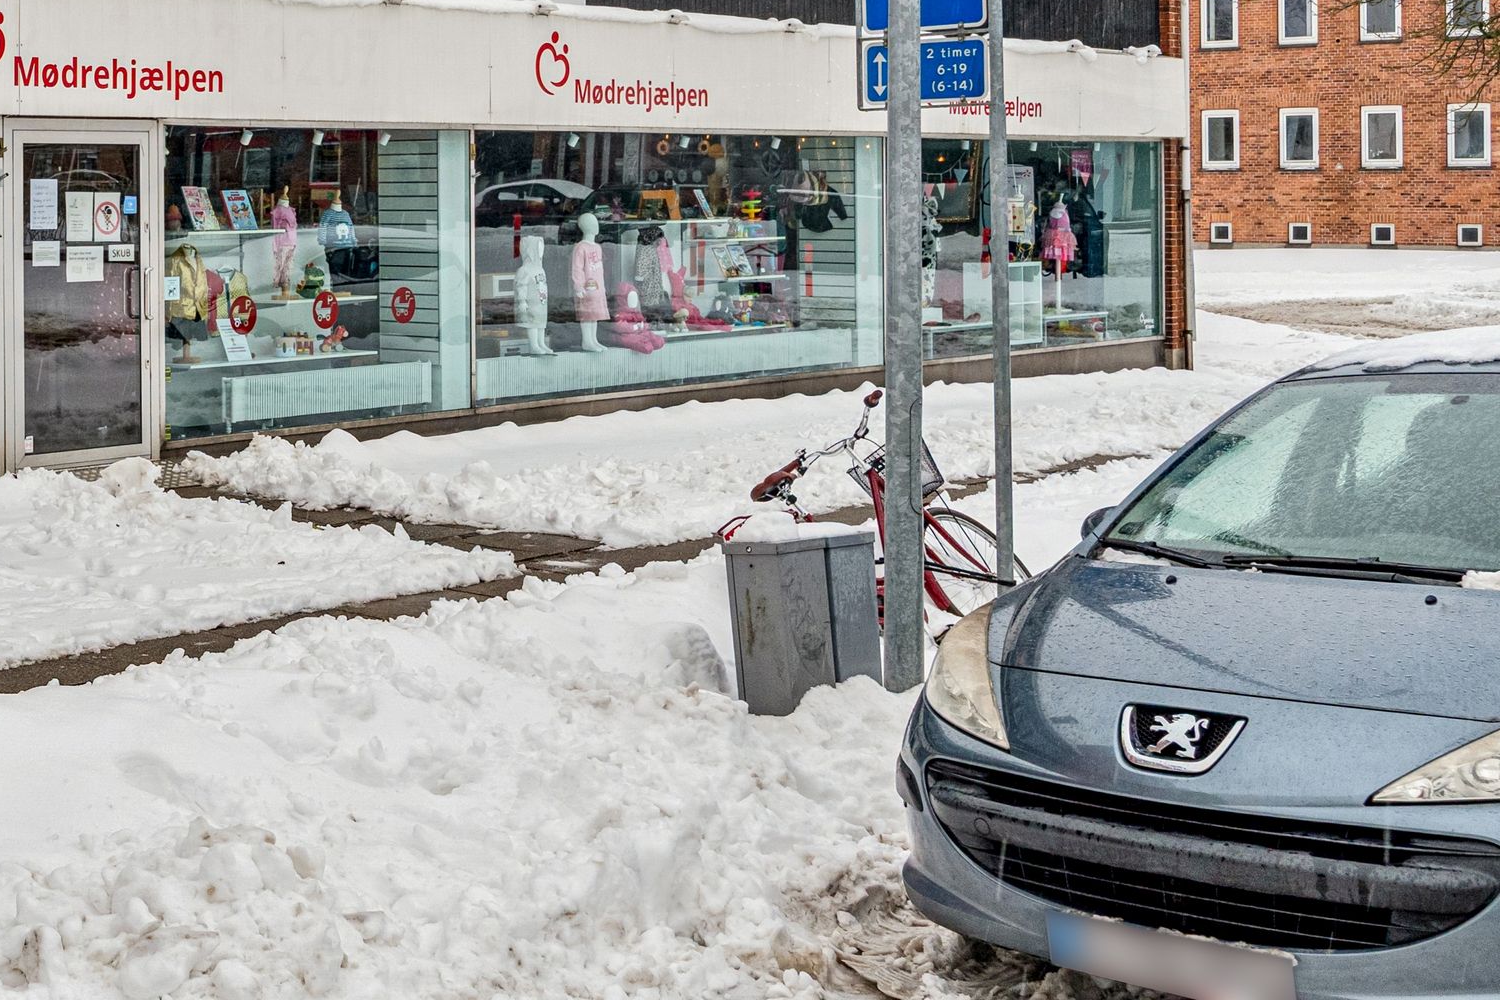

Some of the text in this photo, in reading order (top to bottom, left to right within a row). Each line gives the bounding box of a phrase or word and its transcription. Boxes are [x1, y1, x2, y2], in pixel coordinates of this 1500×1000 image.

[926, 46, 977, 59] 2 timer
[936, 63, 968, 76] 6-19
[13, 55, 224, 101] Mødrehjælpen
[931, 79, 974, 93] (6-14)
[574, 78, 709, 114] Mødrehjælpen
[112, 248, 131, 258] SKUB
